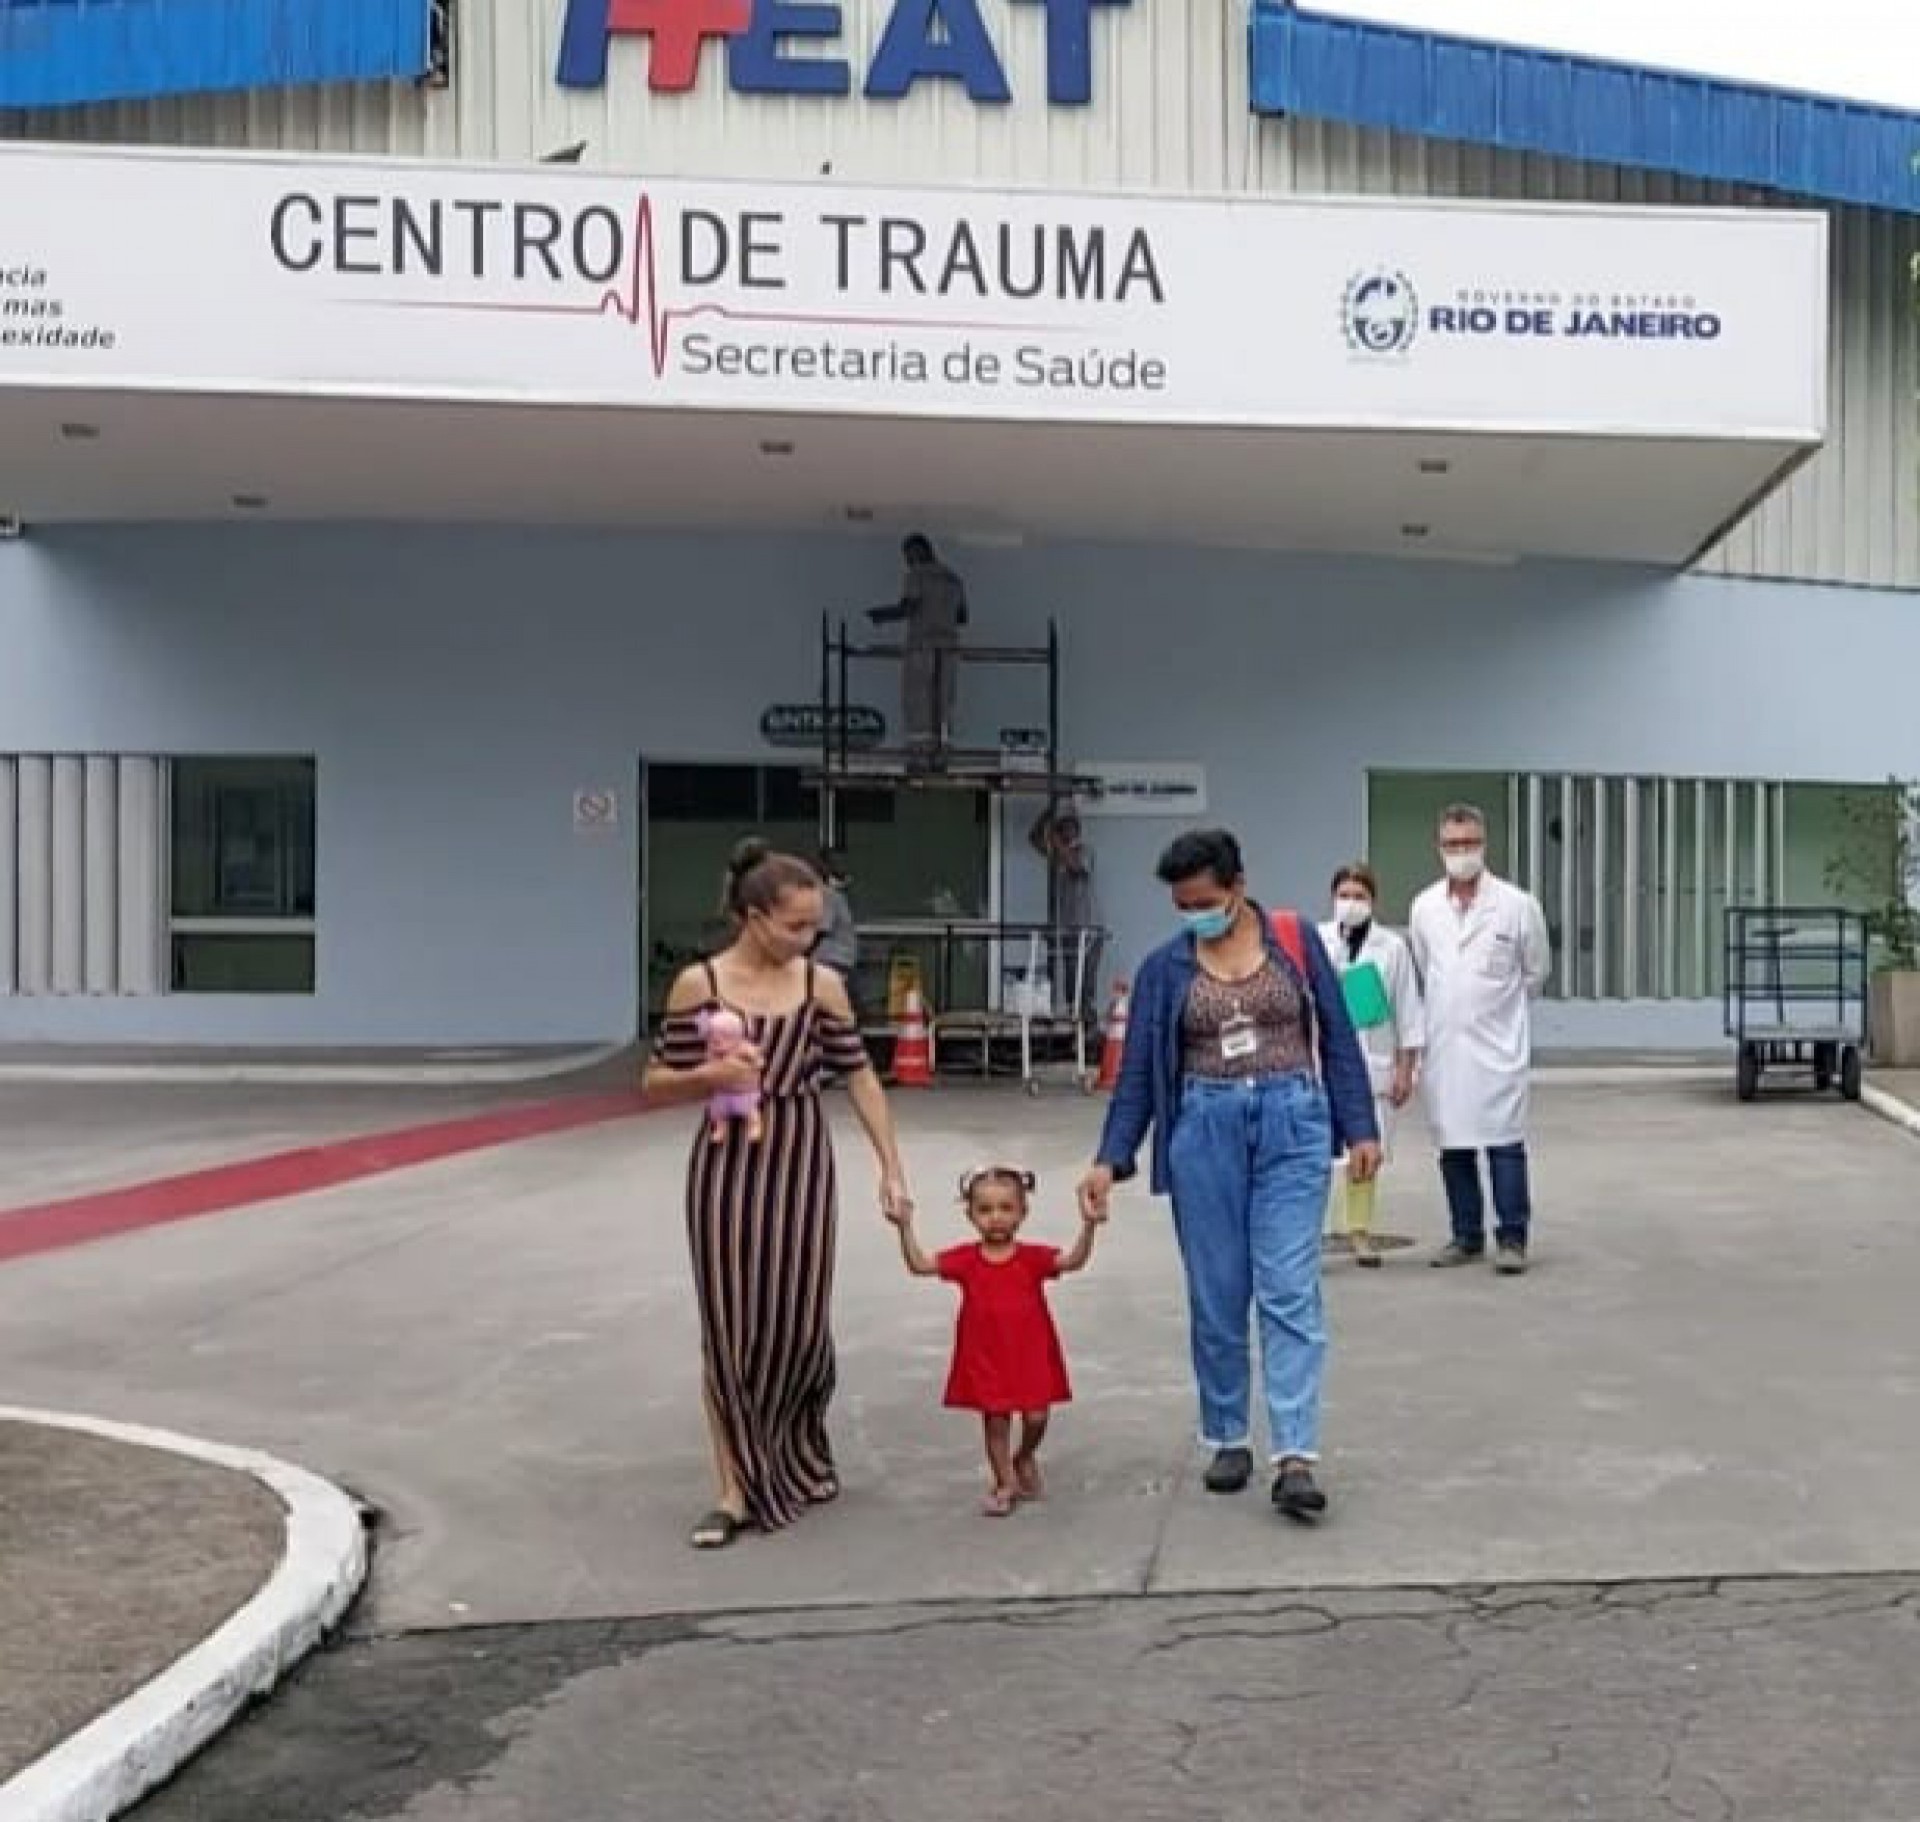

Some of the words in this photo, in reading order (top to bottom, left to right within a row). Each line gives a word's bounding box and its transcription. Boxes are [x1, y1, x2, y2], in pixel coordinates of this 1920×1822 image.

[270, 192, 624, 284] CENTRO
[680, 208, 787, 290] DE
[819, 214, 1166, 304] TRAUMA
[1430, 305, 1498, 332] RIO
[1505, 308, 1554, 335] DE
[1564, 311, 1721, 340] JANEIRO
[682, 333, 928, 383] Secretaria
[943, 342, 1002, 385] de
[1015, 346, 1167, 390] Saúde
